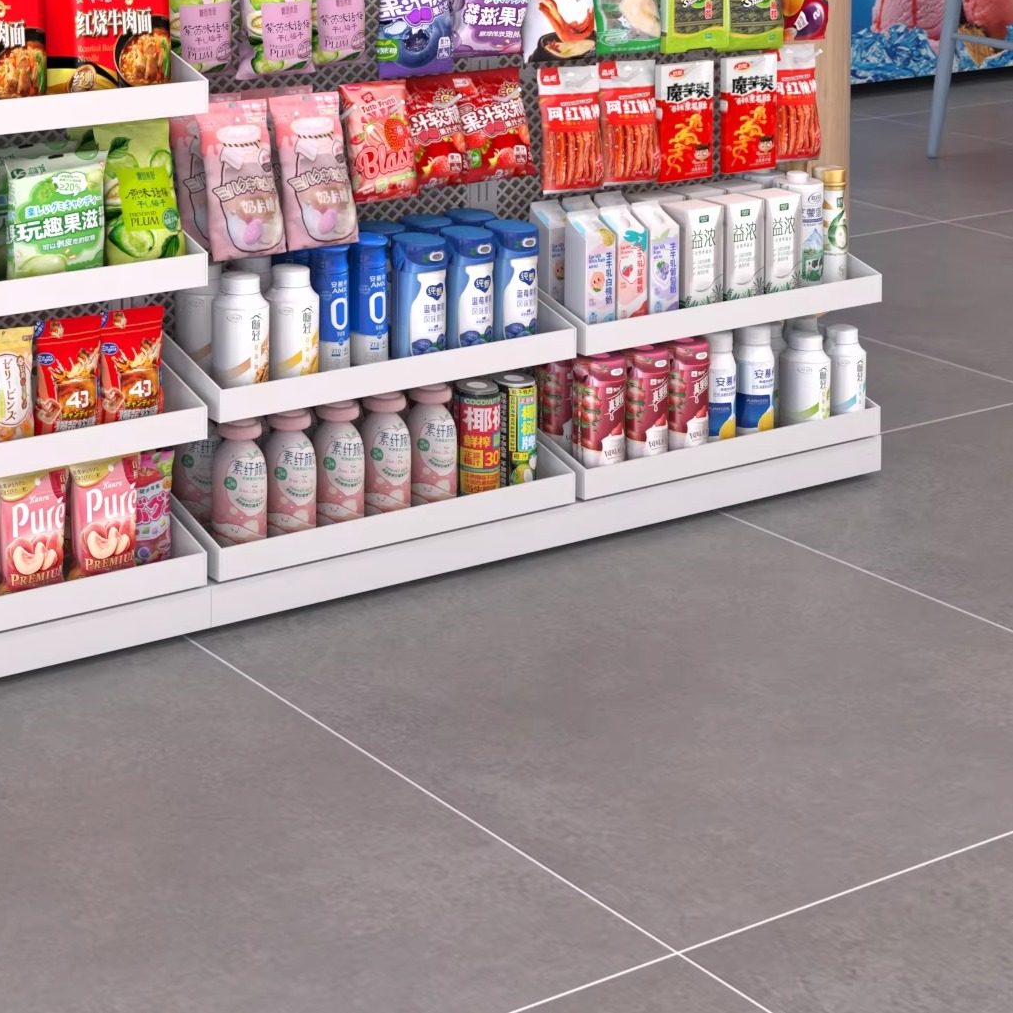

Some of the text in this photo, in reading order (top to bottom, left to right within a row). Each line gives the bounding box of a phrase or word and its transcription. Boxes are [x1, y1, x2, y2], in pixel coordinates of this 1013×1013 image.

[75, 8, 152, 37] 红烧牛肉面
[667, 82, 710, 102] 魔芋爽
[732, 74, 775, 94] 魔芋爽
[356, 141, 414, 179] Blast
[15, 212, 100, 243] 玩趣果滋
[131, 216, 160, 228] PLUM
[733, 222, 757, 243] 益浓
[772, 216, 796, 237] 益浓
[692, 228, 716, 250] 益浓
[86, 483, 137, 523] Puré
[11, 497, 65, 539] Puré
